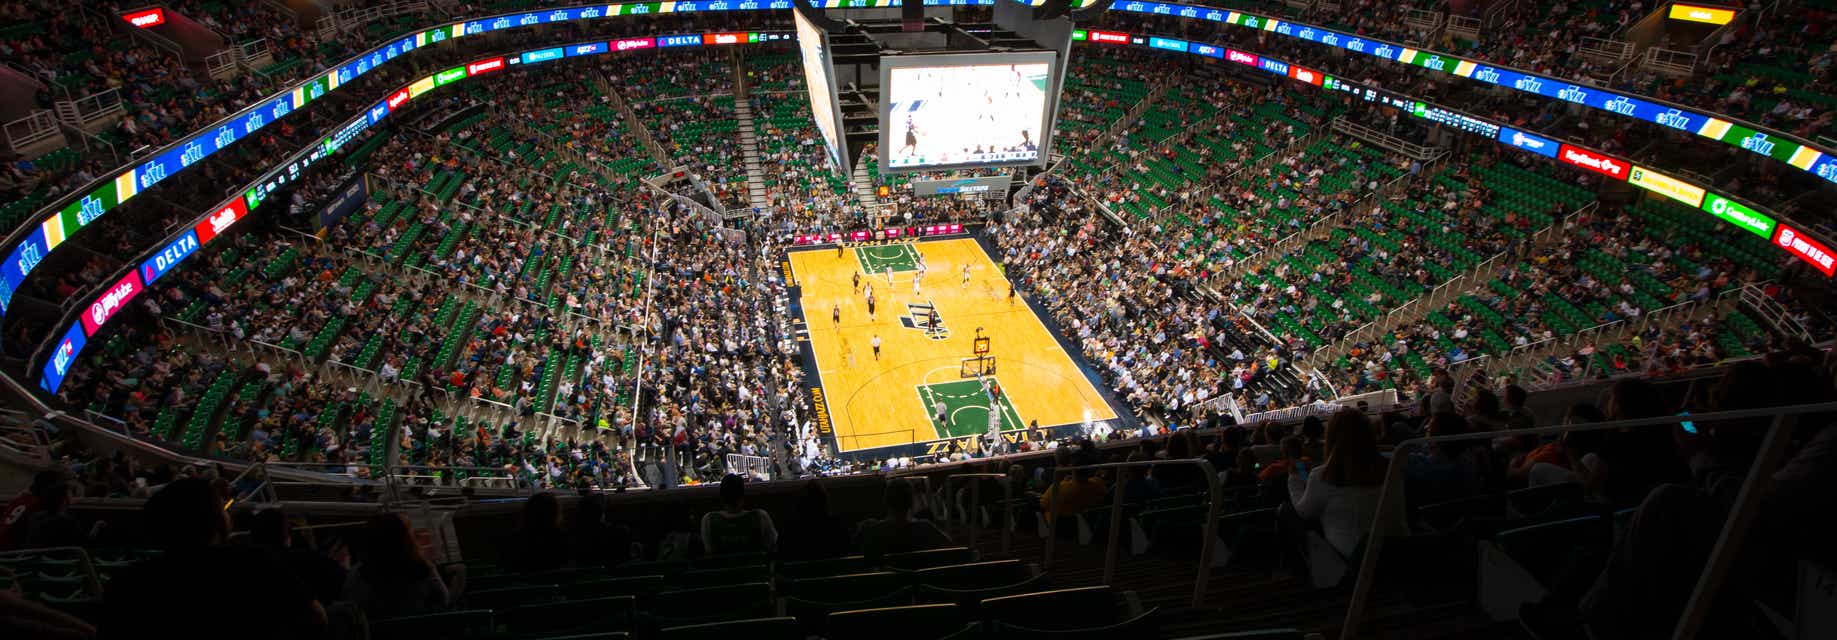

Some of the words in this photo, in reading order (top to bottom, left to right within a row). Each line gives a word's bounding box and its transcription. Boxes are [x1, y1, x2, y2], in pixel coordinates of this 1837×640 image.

[668, 36, 700, 45] DELTA
[1265, 60, 1287, 73] DELTA
[1565, 150, 1600, 168] KeyBank
[155, 234, 197, 271] DELTA
